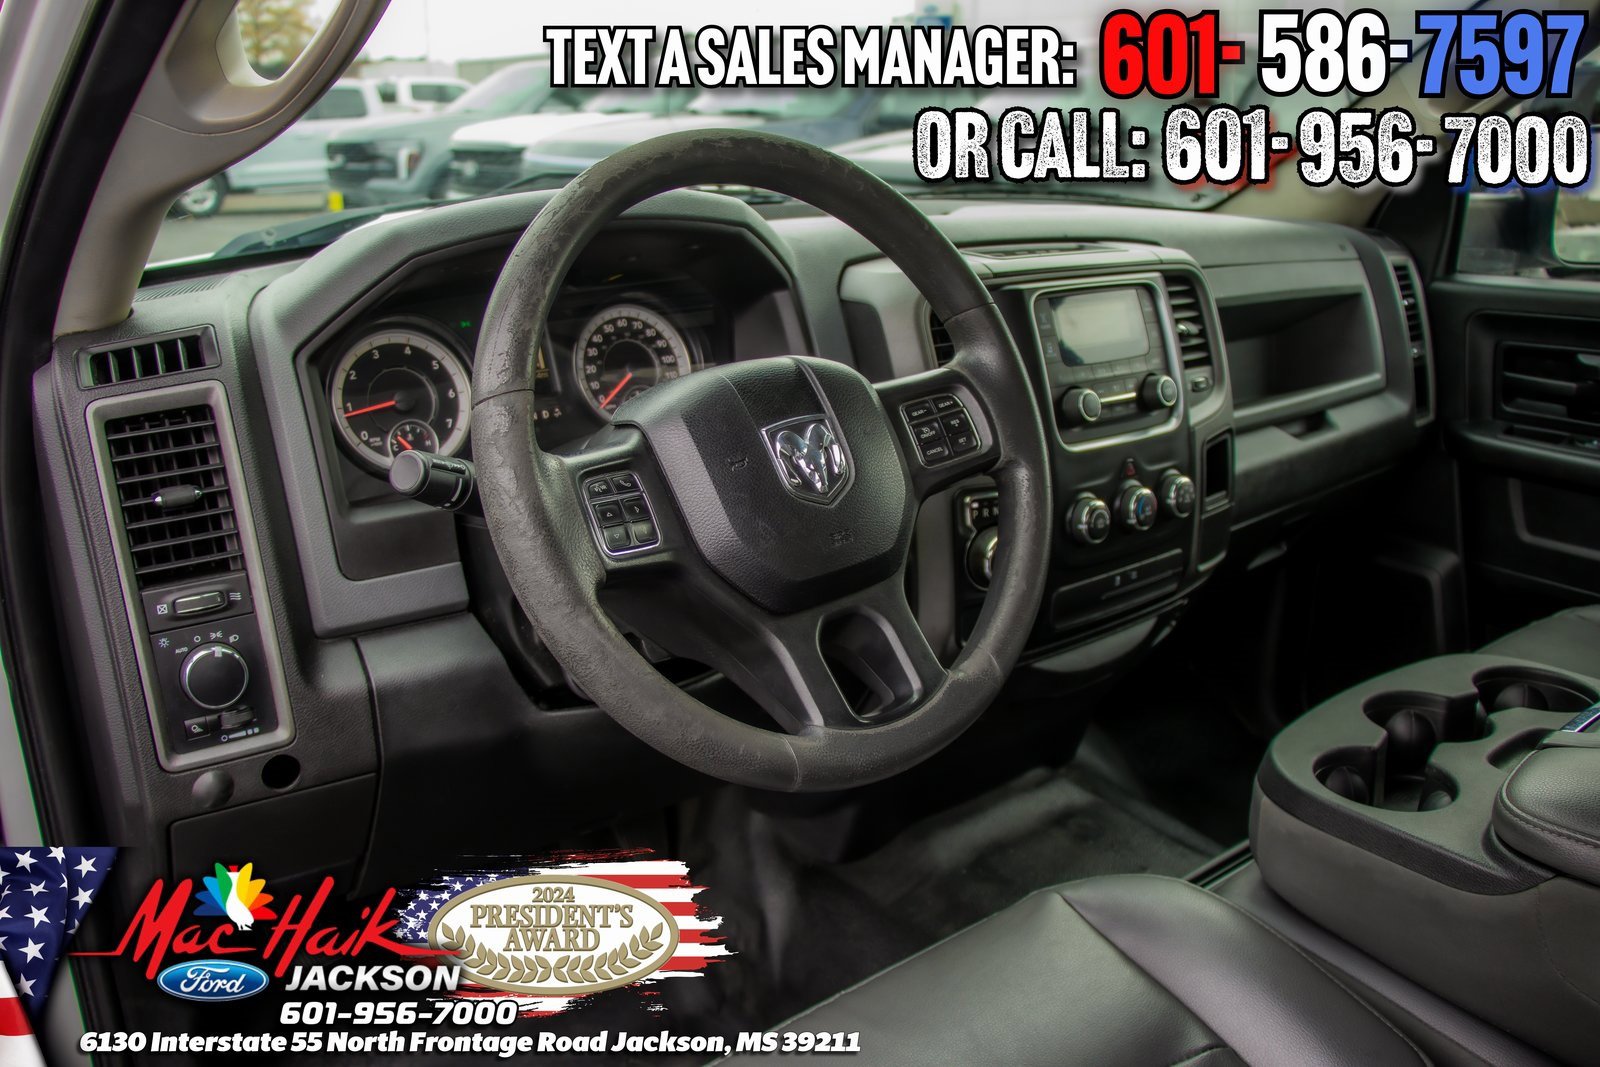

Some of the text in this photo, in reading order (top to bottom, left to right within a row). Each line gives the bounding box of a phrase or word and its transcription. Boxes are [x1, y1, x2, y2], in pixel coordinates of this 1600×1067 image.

[617, 319, 628, 328] 60
[632, 321, 643, 330] 70
[603, 324, 615, 334] 50
[645, 329, 657, 338] 80
[592, 334, 604, 344] 40
[656, 339, 668, 349] 90
[372, 349, 381, 360] 3
[404, 345, 412, 356] 4
[662, 355, 676, 364] 100
[431, 360, 440, 371] 5
[585, 364, 597, 374] 20
[349, 370, 358, 381] 2
[590, 381, 601, 391] 10
[447, 390, 456, 399] 6
[445, 418, 454, 429] 7
[360, 430, 369, 442] 0
